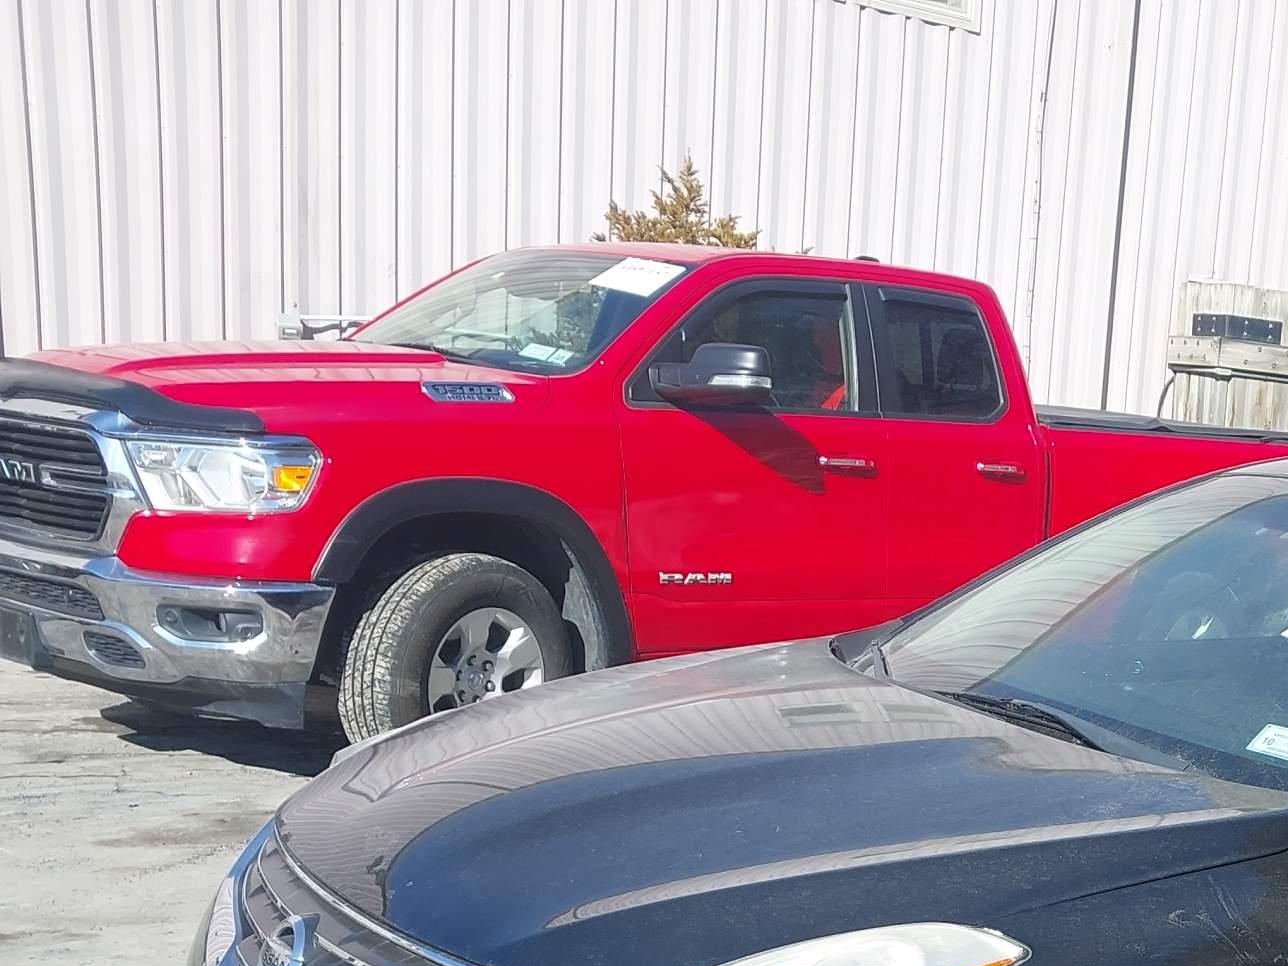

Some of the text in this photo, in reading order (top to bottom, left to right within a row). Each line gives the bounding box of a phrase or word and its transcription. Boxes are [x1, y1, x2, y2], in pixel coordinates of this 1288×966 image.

[433, 385, 500, 395] 1500
[659, 572, 732, 584] RAM
[1262, 737, 1275, 746] 10
